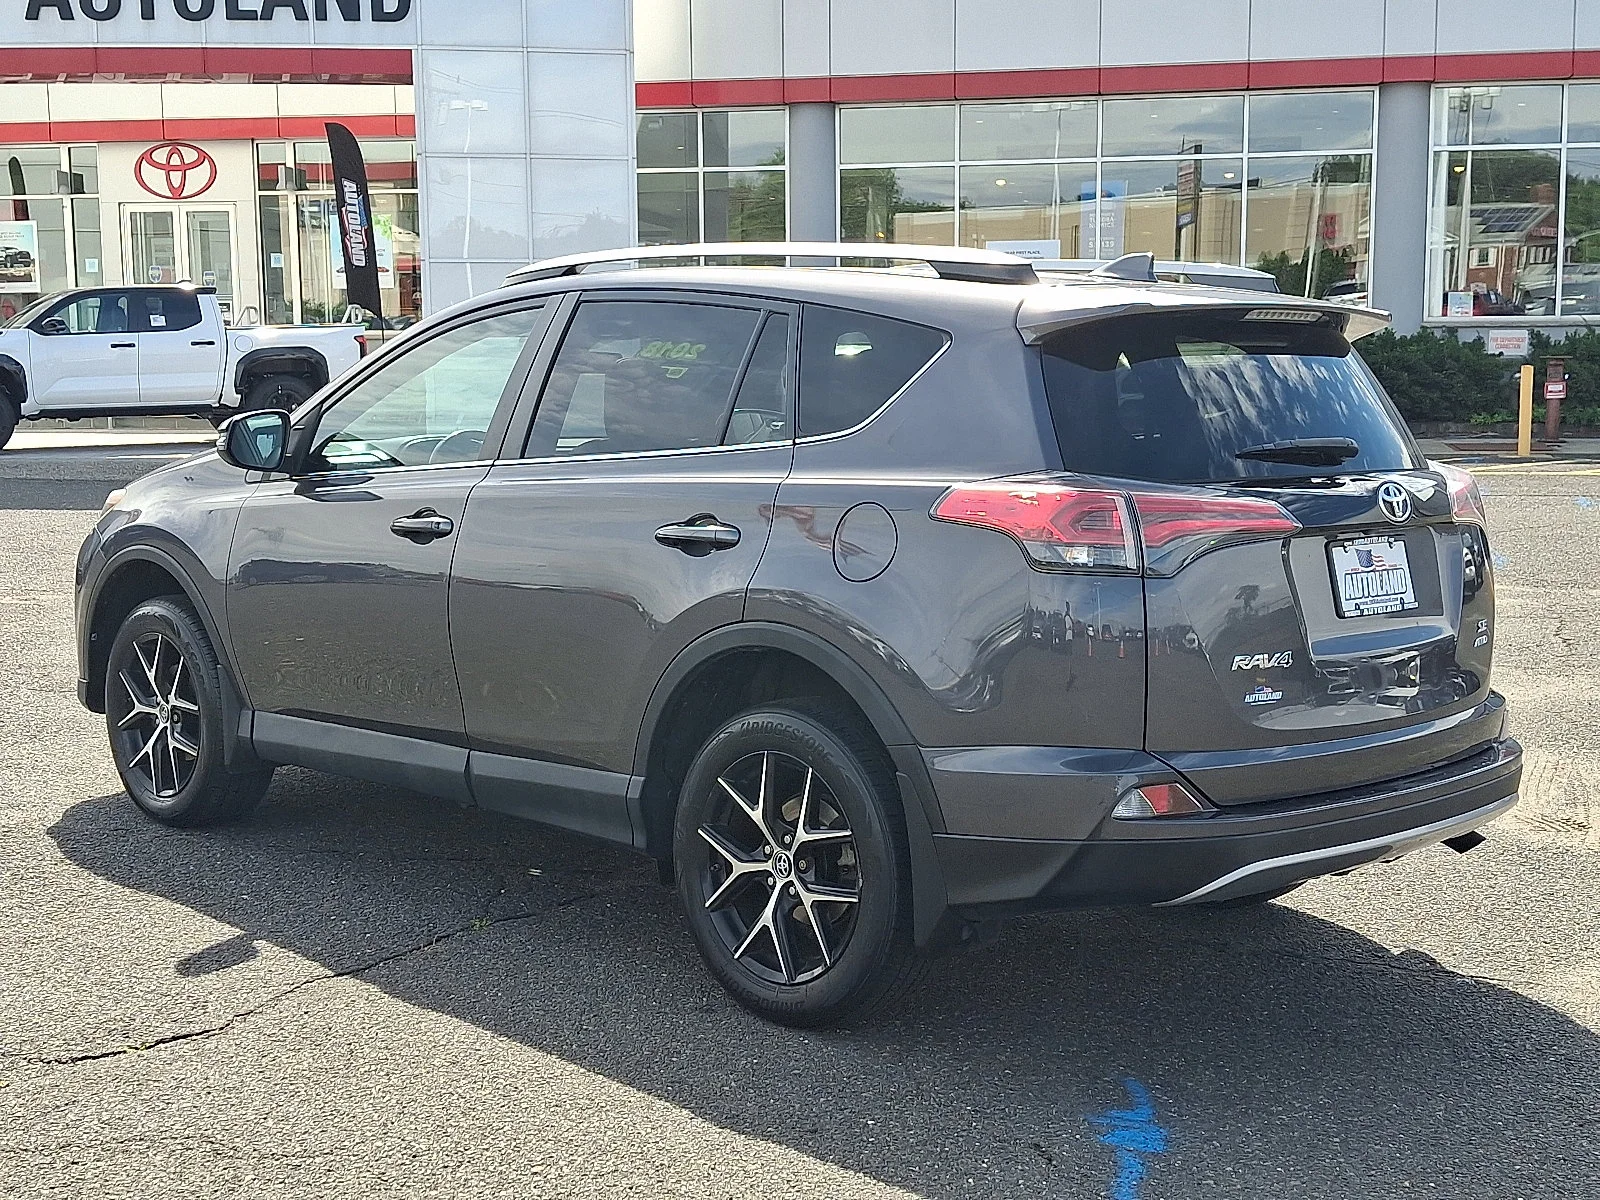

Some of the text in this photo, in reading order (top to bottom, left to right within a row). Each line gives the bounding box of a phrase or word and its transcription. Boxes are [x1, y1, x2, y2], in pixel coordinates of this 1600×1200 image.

[342, 178, 367, 268] AUTOLAND
[1345, 569, 1407, 600] AUTOLAND
[1363, 604, 1402, 616] AUTOLAND
[1230, 650, 1294, 671] RAV4
[1244, 691, 1283, 703] AUTOLAND
